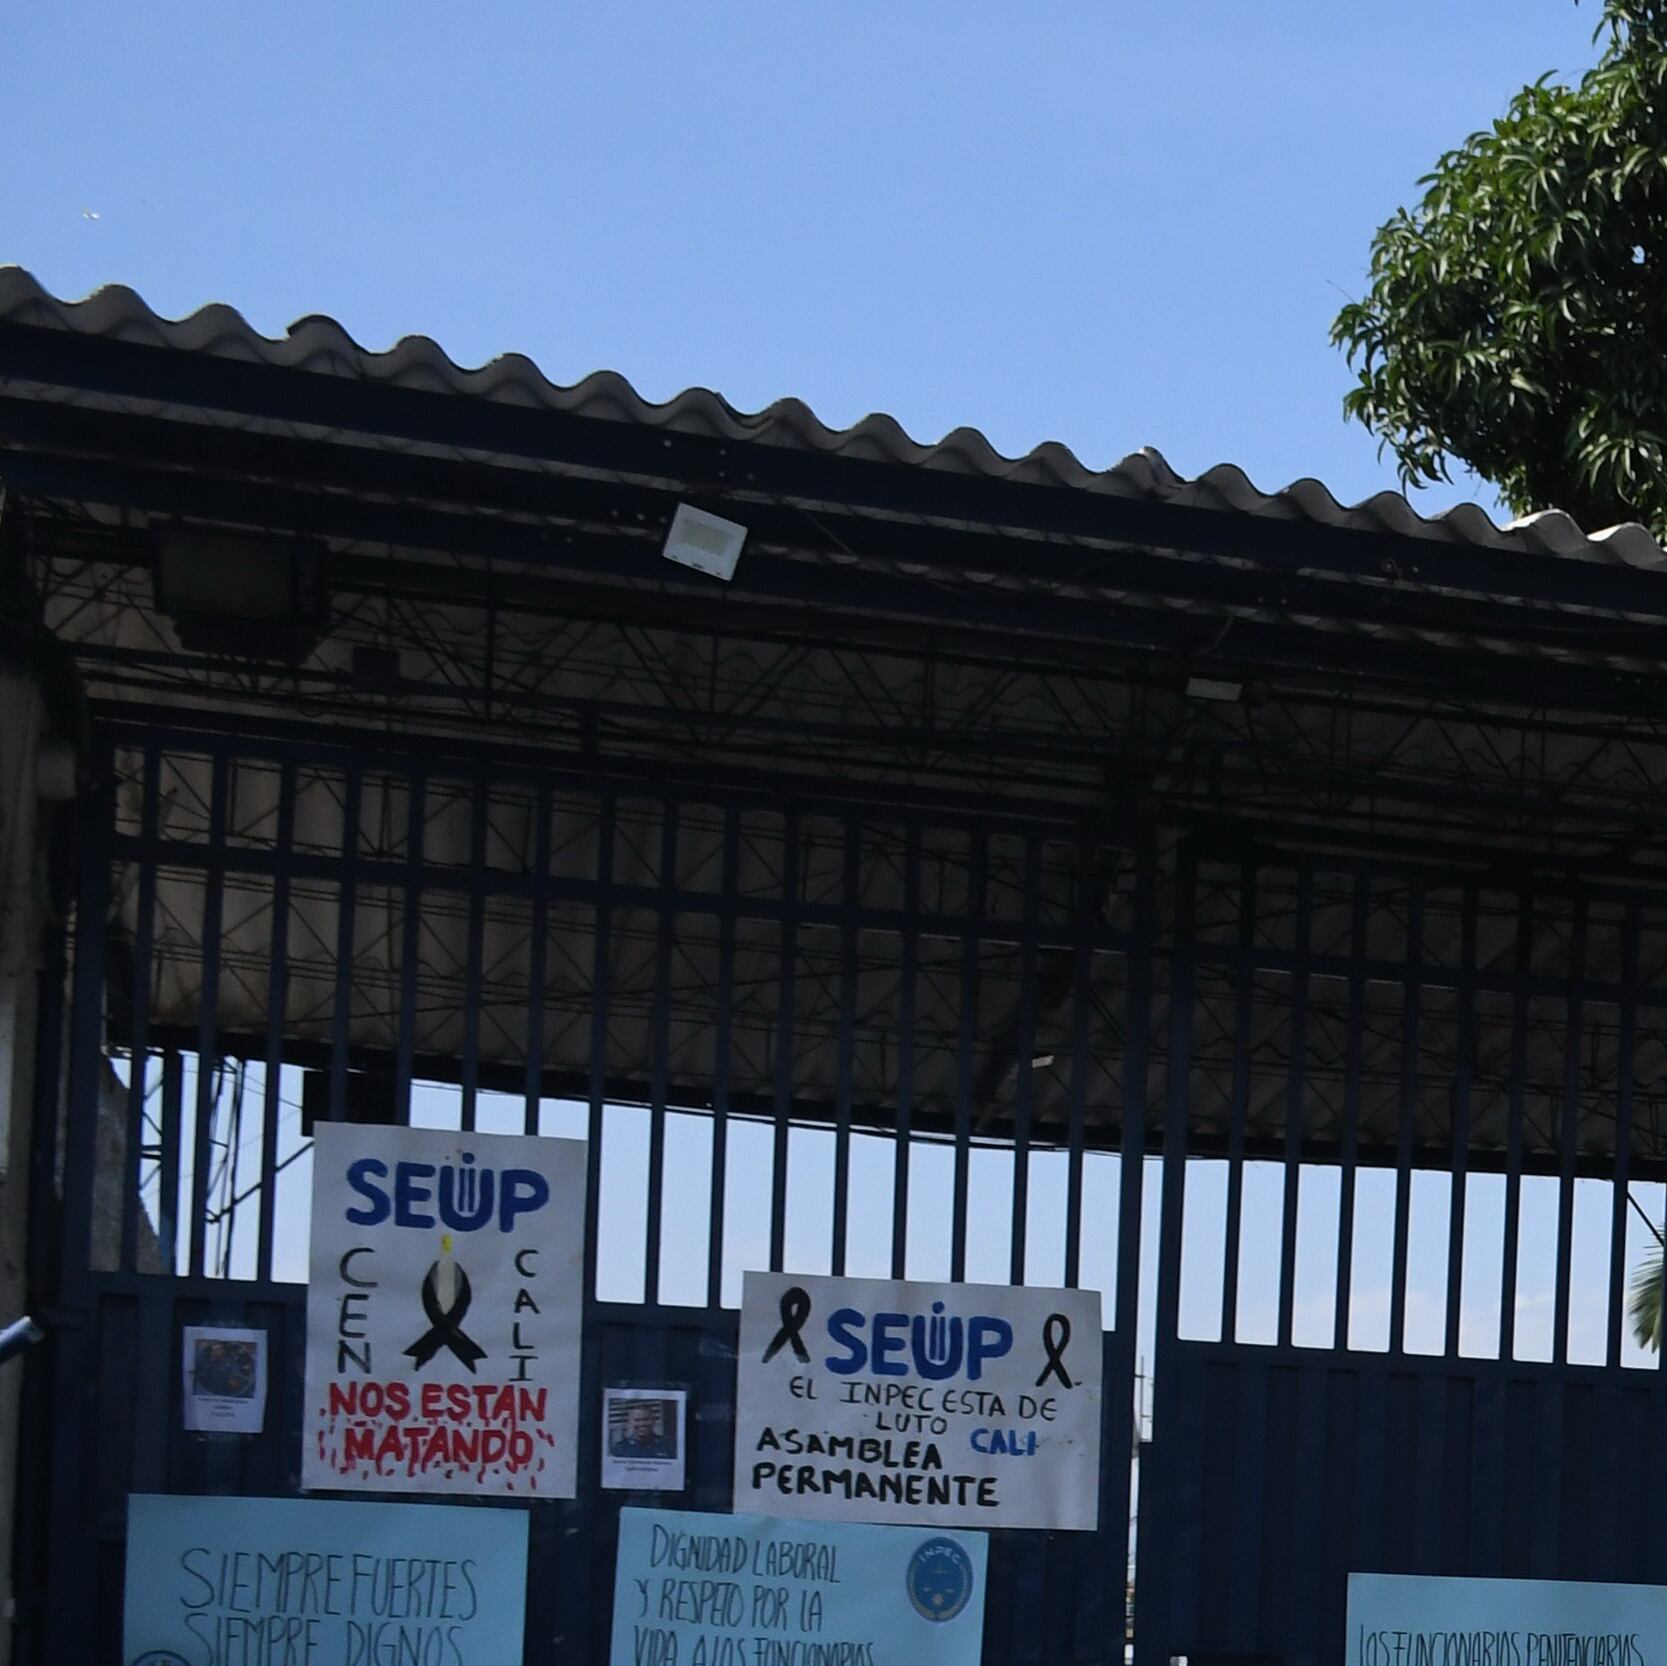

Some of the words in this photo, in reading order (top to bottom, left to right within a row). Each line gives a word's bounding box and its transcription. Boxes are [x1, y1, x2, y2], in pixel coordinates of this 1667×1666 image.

[344, 1151, 549, 1234] SEUP
[824, 1299, 1014, 1382] SEUP
[326, 1380, 417, 1421] NOS
[420, 1382, 549, 1425] ESTAN
[789, 1375, 818, 1401] EL
[840, 1380, 936, 1414] INPEC
[942, 1387, 1006, 1418] ESTA
[1018, 1393, 1059, 1423] DE
[756, 1426, 943, 1471] ASAMBLEA
[876, 1413, 949, 1436] LUTO
[968, 1427, 1039, 1457] CALI
[342, 1426, 534, 1472] MATANDO
[751, 1460, 1000, 1508] PERMANENTE
[649, 1523, 748, 1575] DIGNIDAD
[752, 1539, 842, 1584] LABORAL
[918, 1545, 963, 1566] INPEC
[180, 1547, 346, 1616] SIEMPRE
[348, 1552, 479, 1623] FUERTES
[633, 1578, 650, 1619] Y
[659, 1578, 745, 1629] RESPETO
[751, 1584, 791, 1632] POR
[800, 1589, 824, 1633] LA
